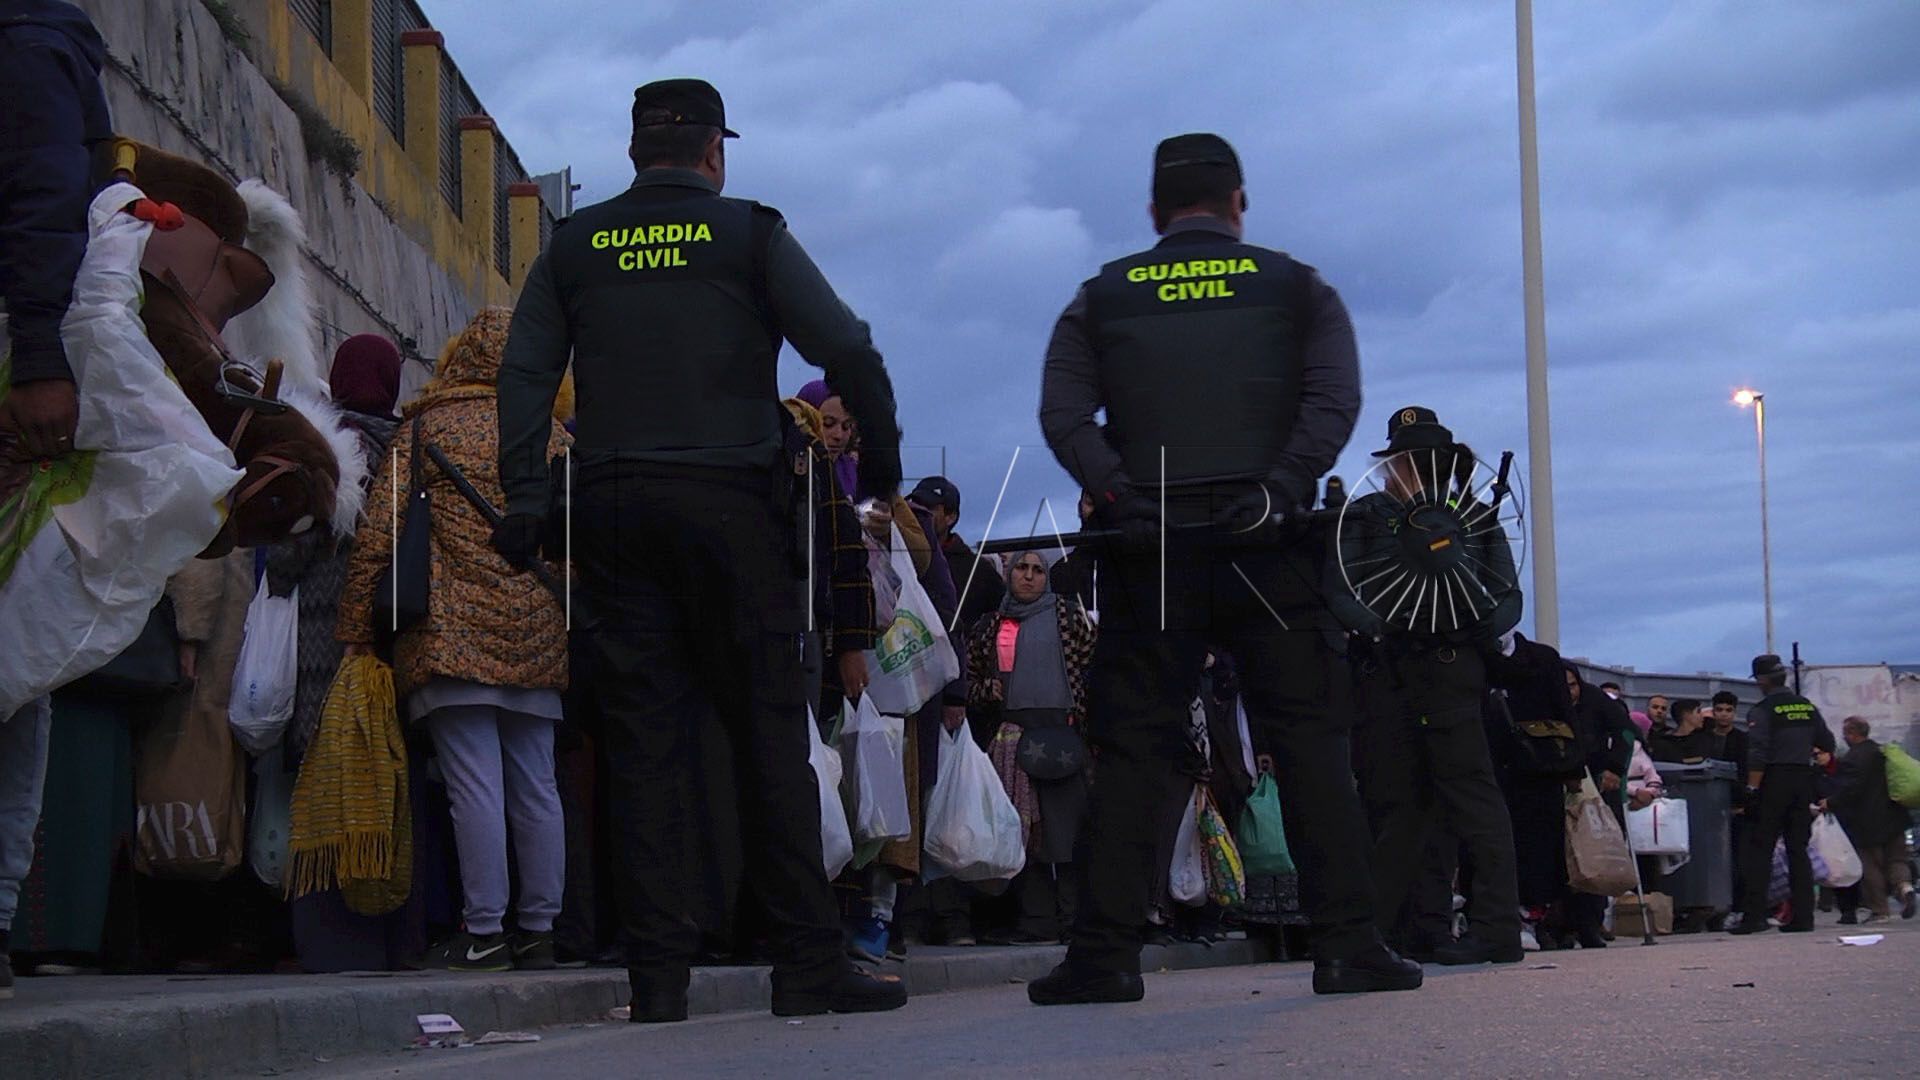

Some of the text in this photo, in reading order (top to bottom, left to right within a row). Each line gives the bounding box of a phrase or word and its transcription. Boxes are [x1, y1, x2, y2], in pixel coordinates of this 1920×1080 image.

[592, 224, 712, 249] GUARDIA
[619, 248, 687, 271] CIVIL
[1127, 258, 1259, 282] GUARDIA
[1158, 280, 1234, 301] CIVIL
